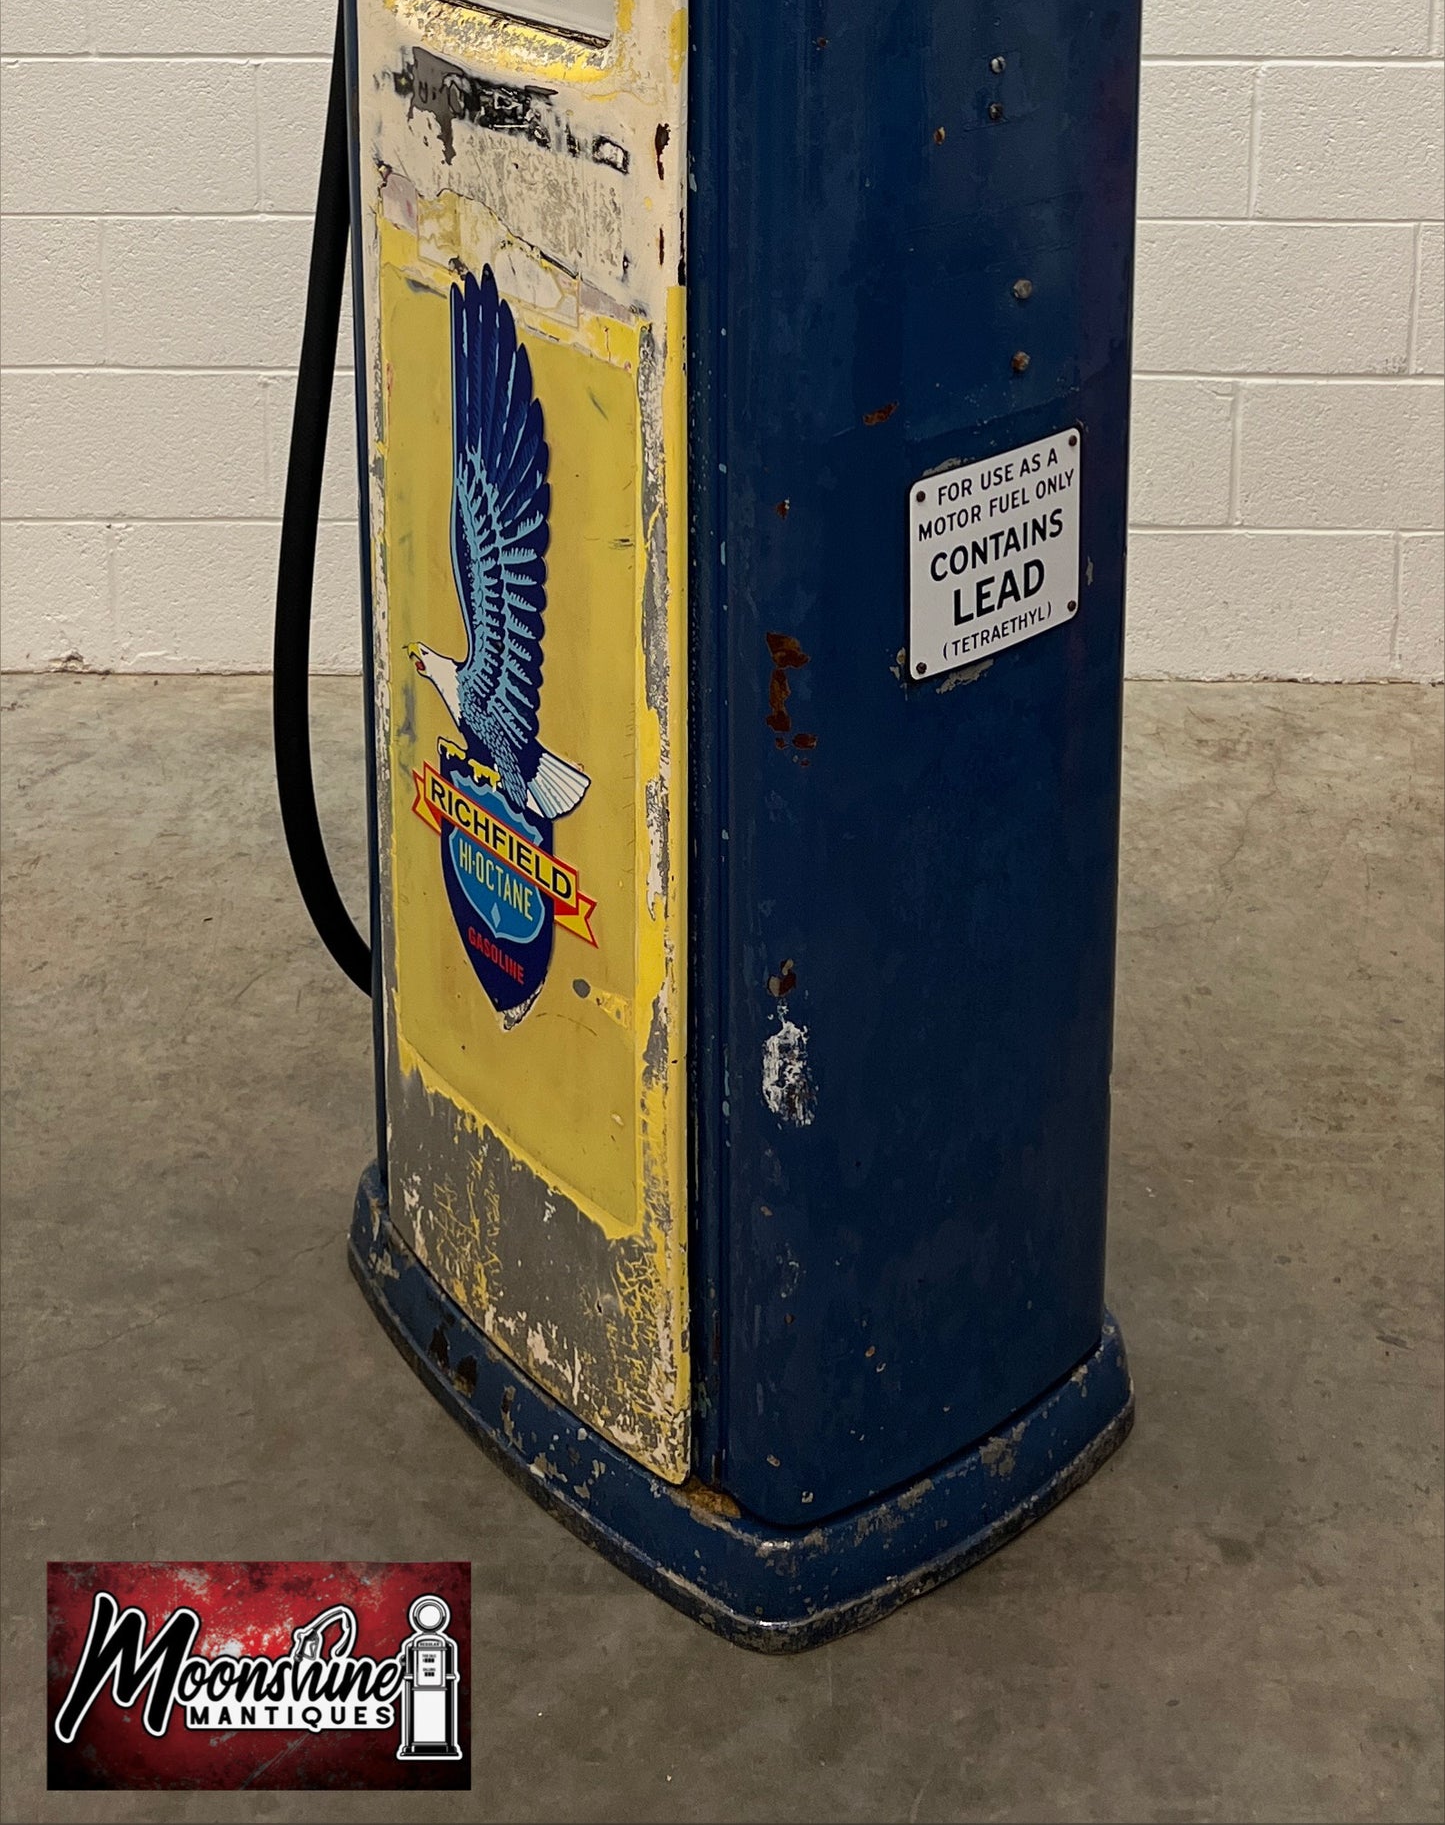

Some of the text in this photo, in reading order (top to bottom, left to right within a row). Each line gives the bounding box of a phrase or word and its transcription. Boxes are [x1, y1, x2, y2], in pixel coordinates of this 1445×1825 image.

[918, 468, 1075, 542] MOTOR FUEL ONLY
[938, 448, 1059, 506] FOR USE AS A
[930, 508, 1064, 582] CONTAINS
[953, 558, 1046, 626] LEAD
[942, 601, 1053, 661] (TETRAETHYL)
[430, 776, 572, 900] RICHFIELD
[467, 925, 525, 986] GASOLINE
